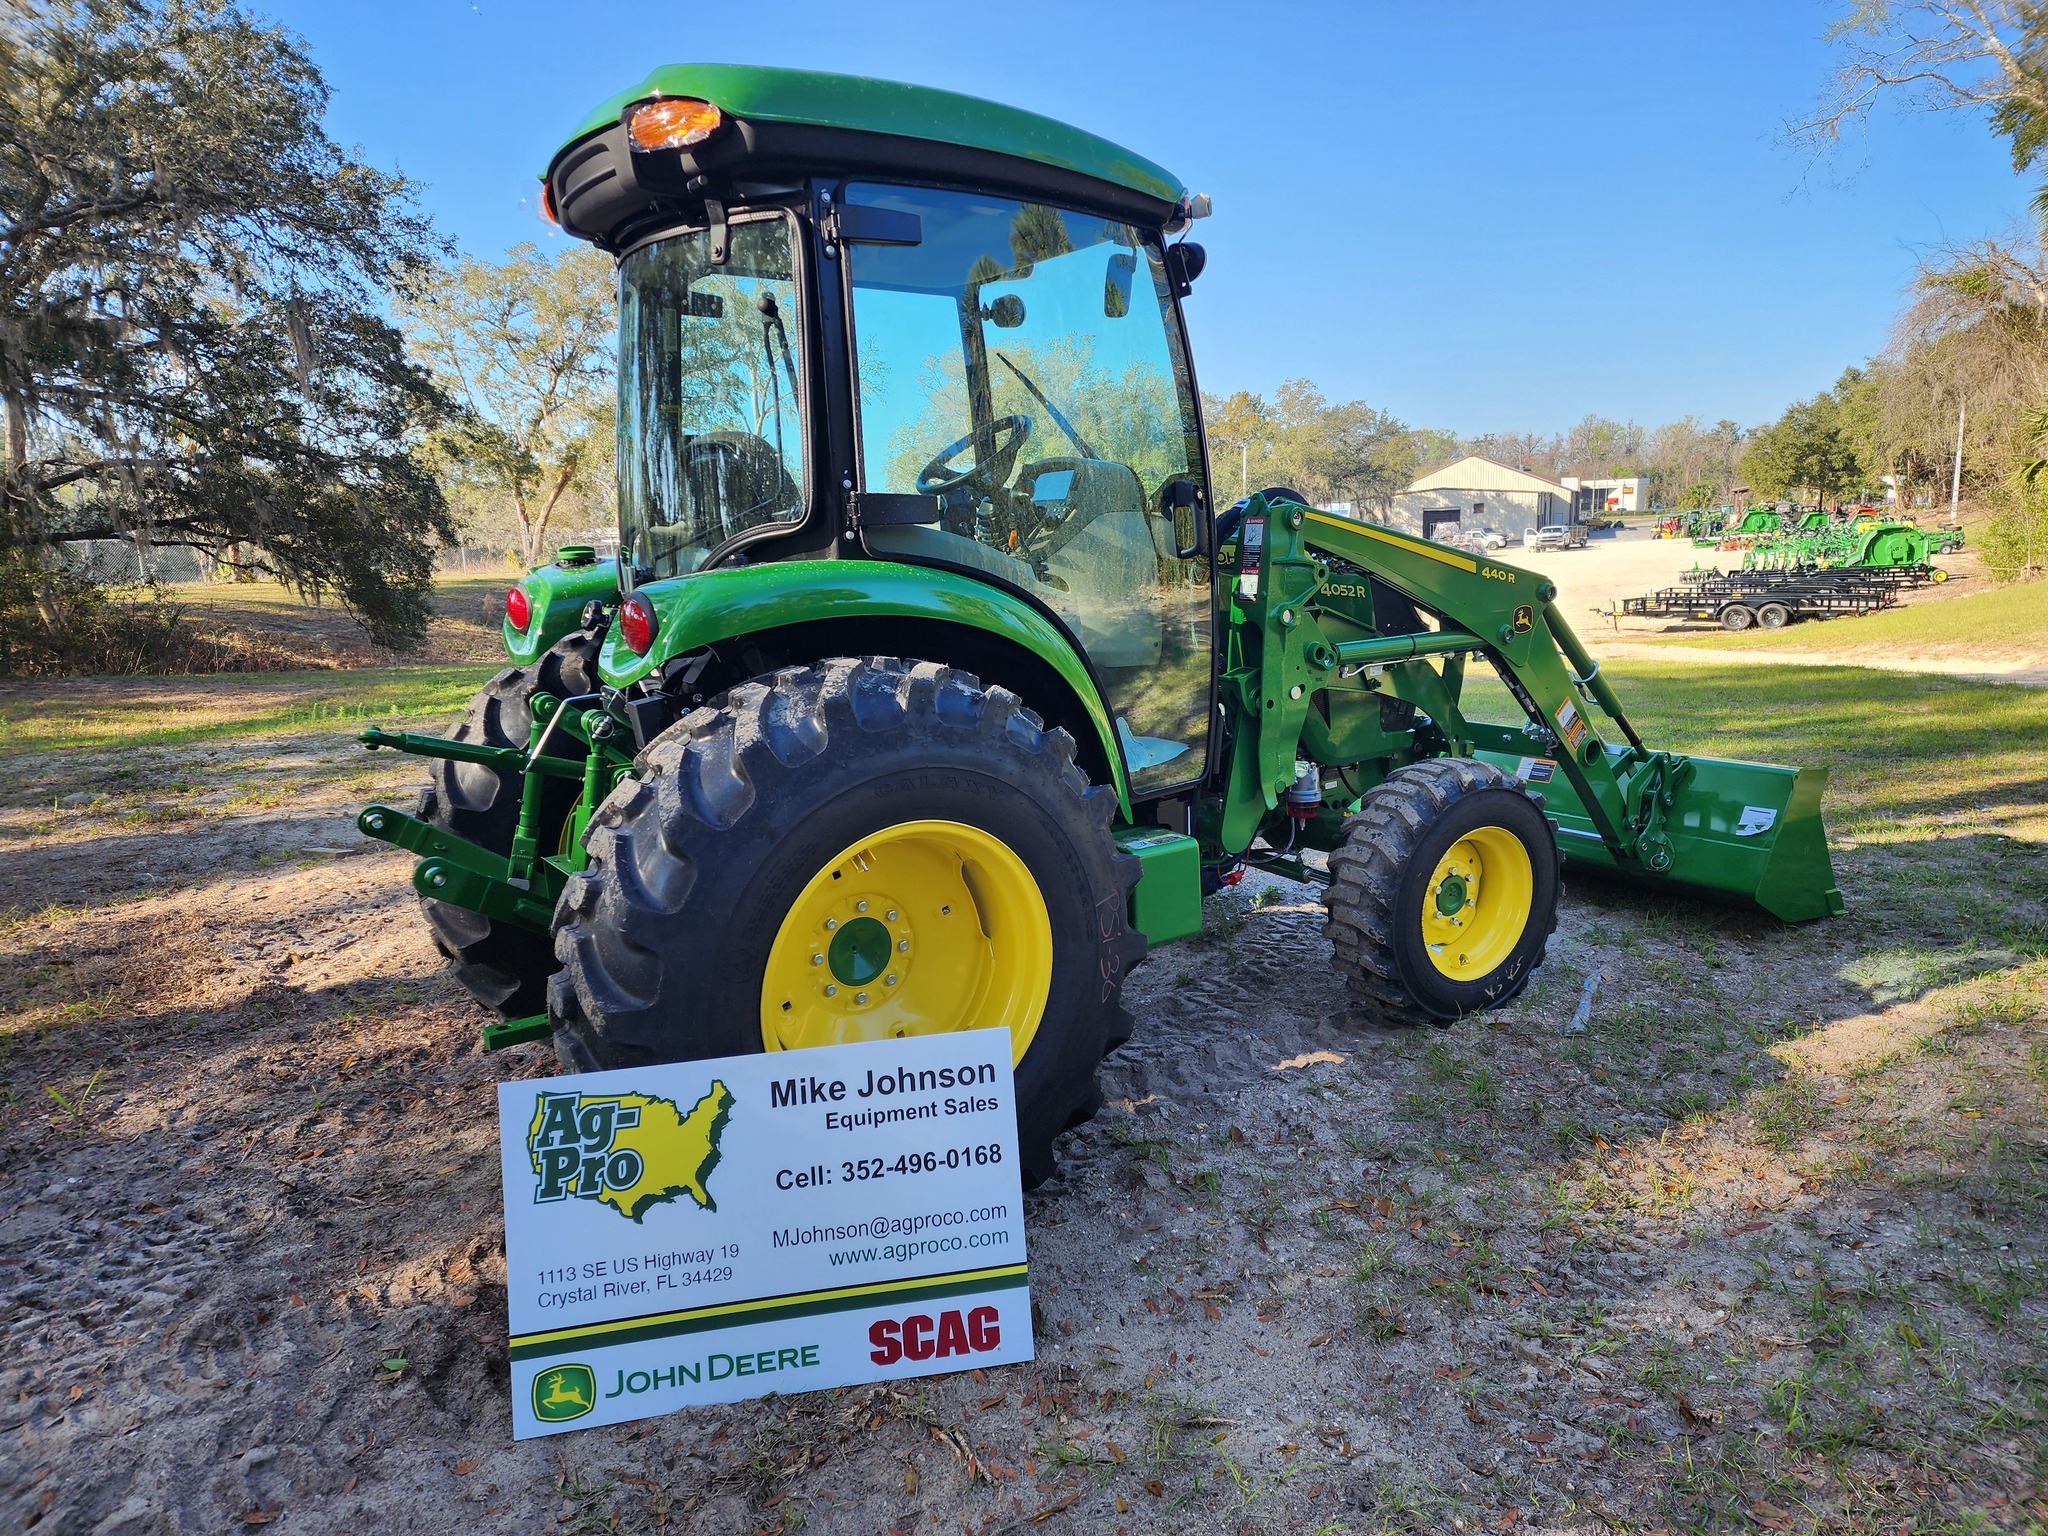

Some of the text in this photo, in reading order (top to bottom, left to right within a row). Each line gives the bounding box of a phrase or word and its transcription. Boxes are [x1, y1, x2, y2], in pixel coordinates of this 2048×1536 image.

[874, 776, 1006, 800] GALAXY
[770, 1063, 996, 1109] Mike Johnson
[533, 1091, 641, 1157] Ag-
[825, 1096, 999, 1132] Equipment Sales
[533, 1147, 644, 1204] Pro
[775, 1143, 1002, 1191] Cell: 352-496-0168
[772, 1204, 1007, 1249] MJohnson@agproco.com
[828, 1230, 1009, 1266] www.agproco.com
[537, 1243, 740, 1285] 1113 SE US Highway 19
[537, 1266, 733, 1309] Crystal River, FL 34429
[868, 1305, 1001, 1366] SCAG
